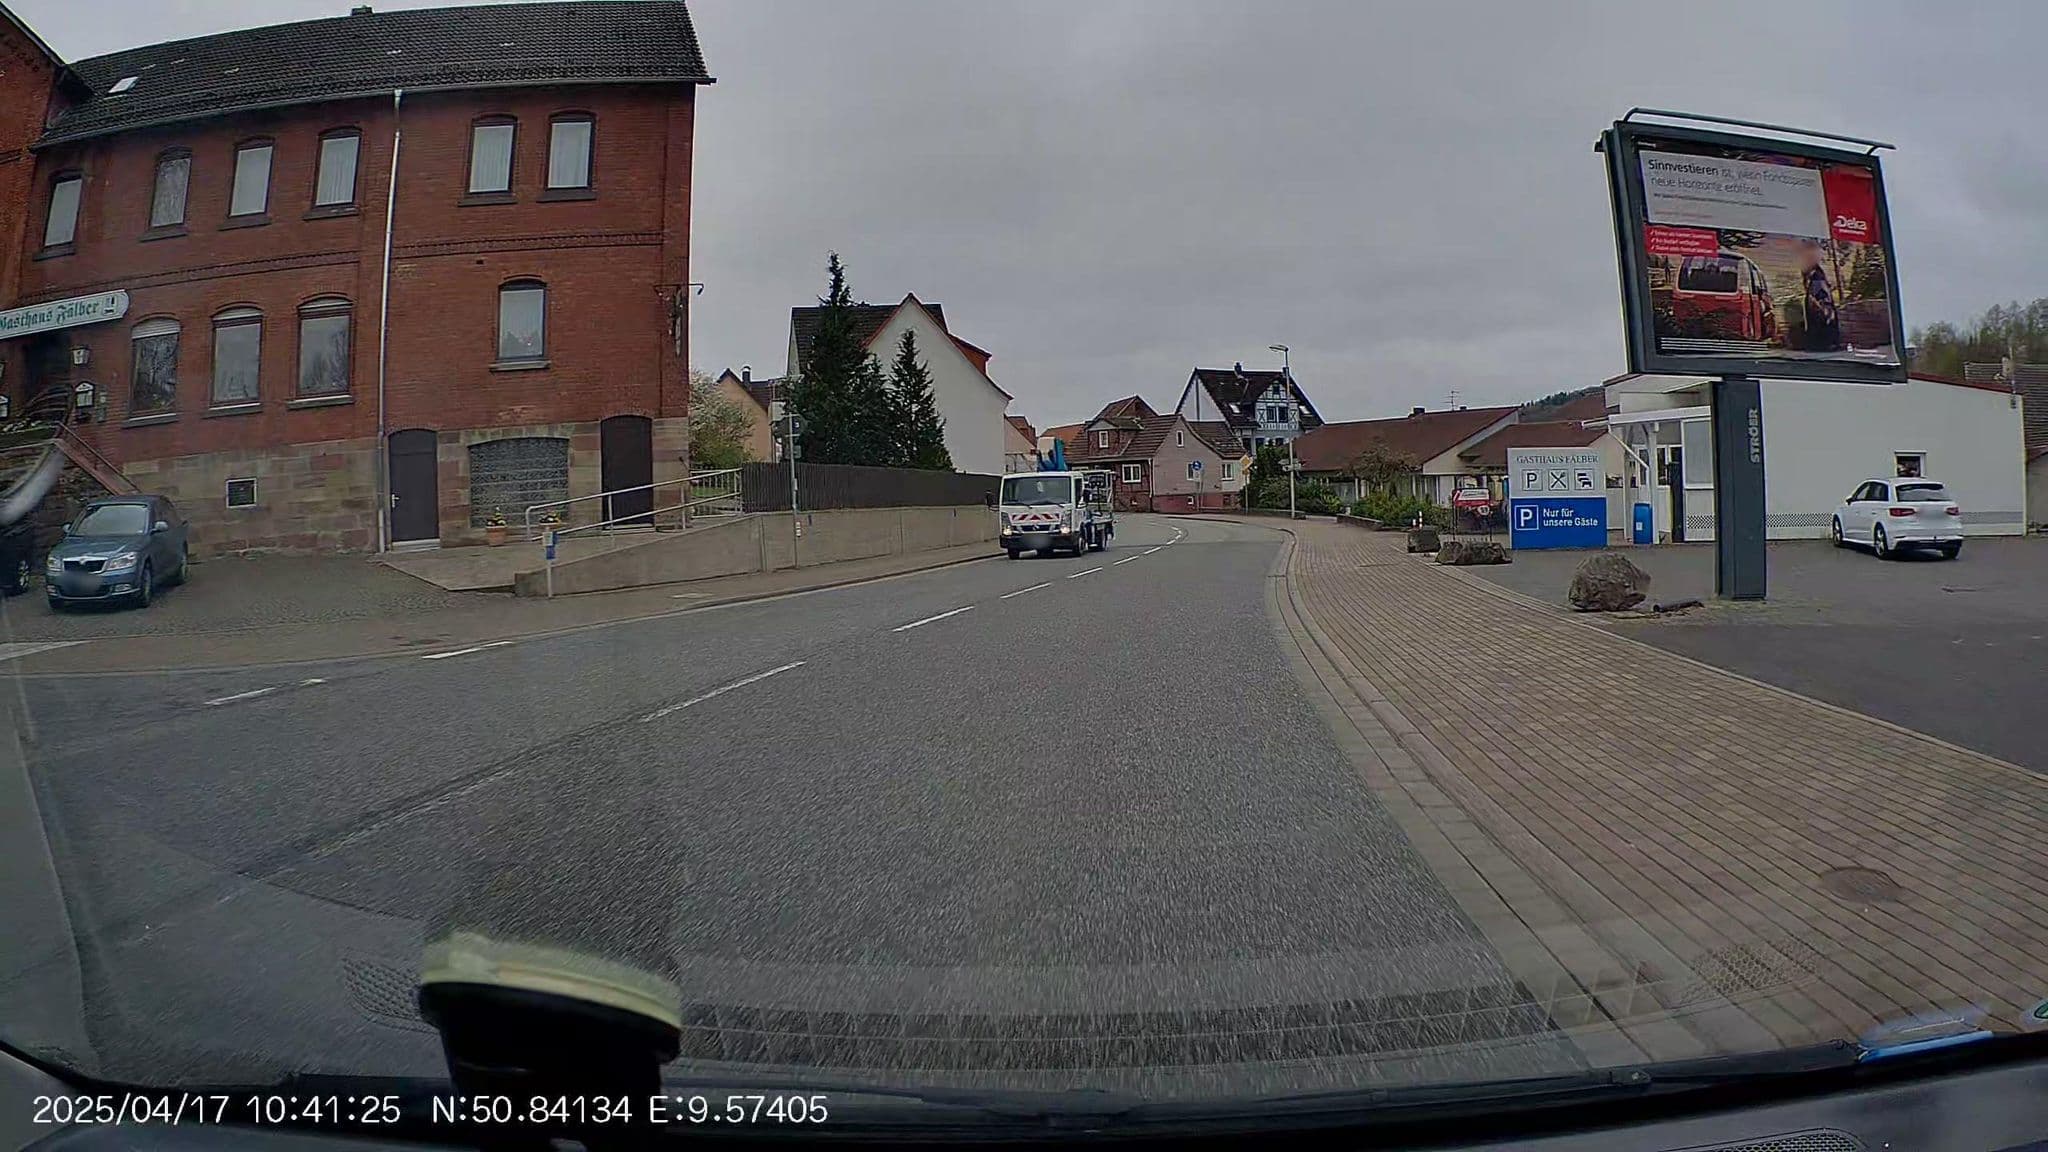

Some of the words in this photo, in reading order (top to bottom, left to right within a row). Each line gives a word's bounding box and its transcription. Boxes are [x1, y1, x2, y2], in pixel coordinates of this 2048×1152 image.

[1648, 159, 1719, 176] Sinnvestieren
[1833, 215, 1868, 230] Deka
[56, 301, 100, 326] Fälber
[1748, 408, 1760, 463] STRÖER
[1516, 454, 1564, 464] GASTHAUS
[1543, 508, 1559, 517] Nur
[1561, 507, 1574, 517] für
[1543, 518, 1573, 527] unsere
[1574, 517, 1599, 527] Gäste
